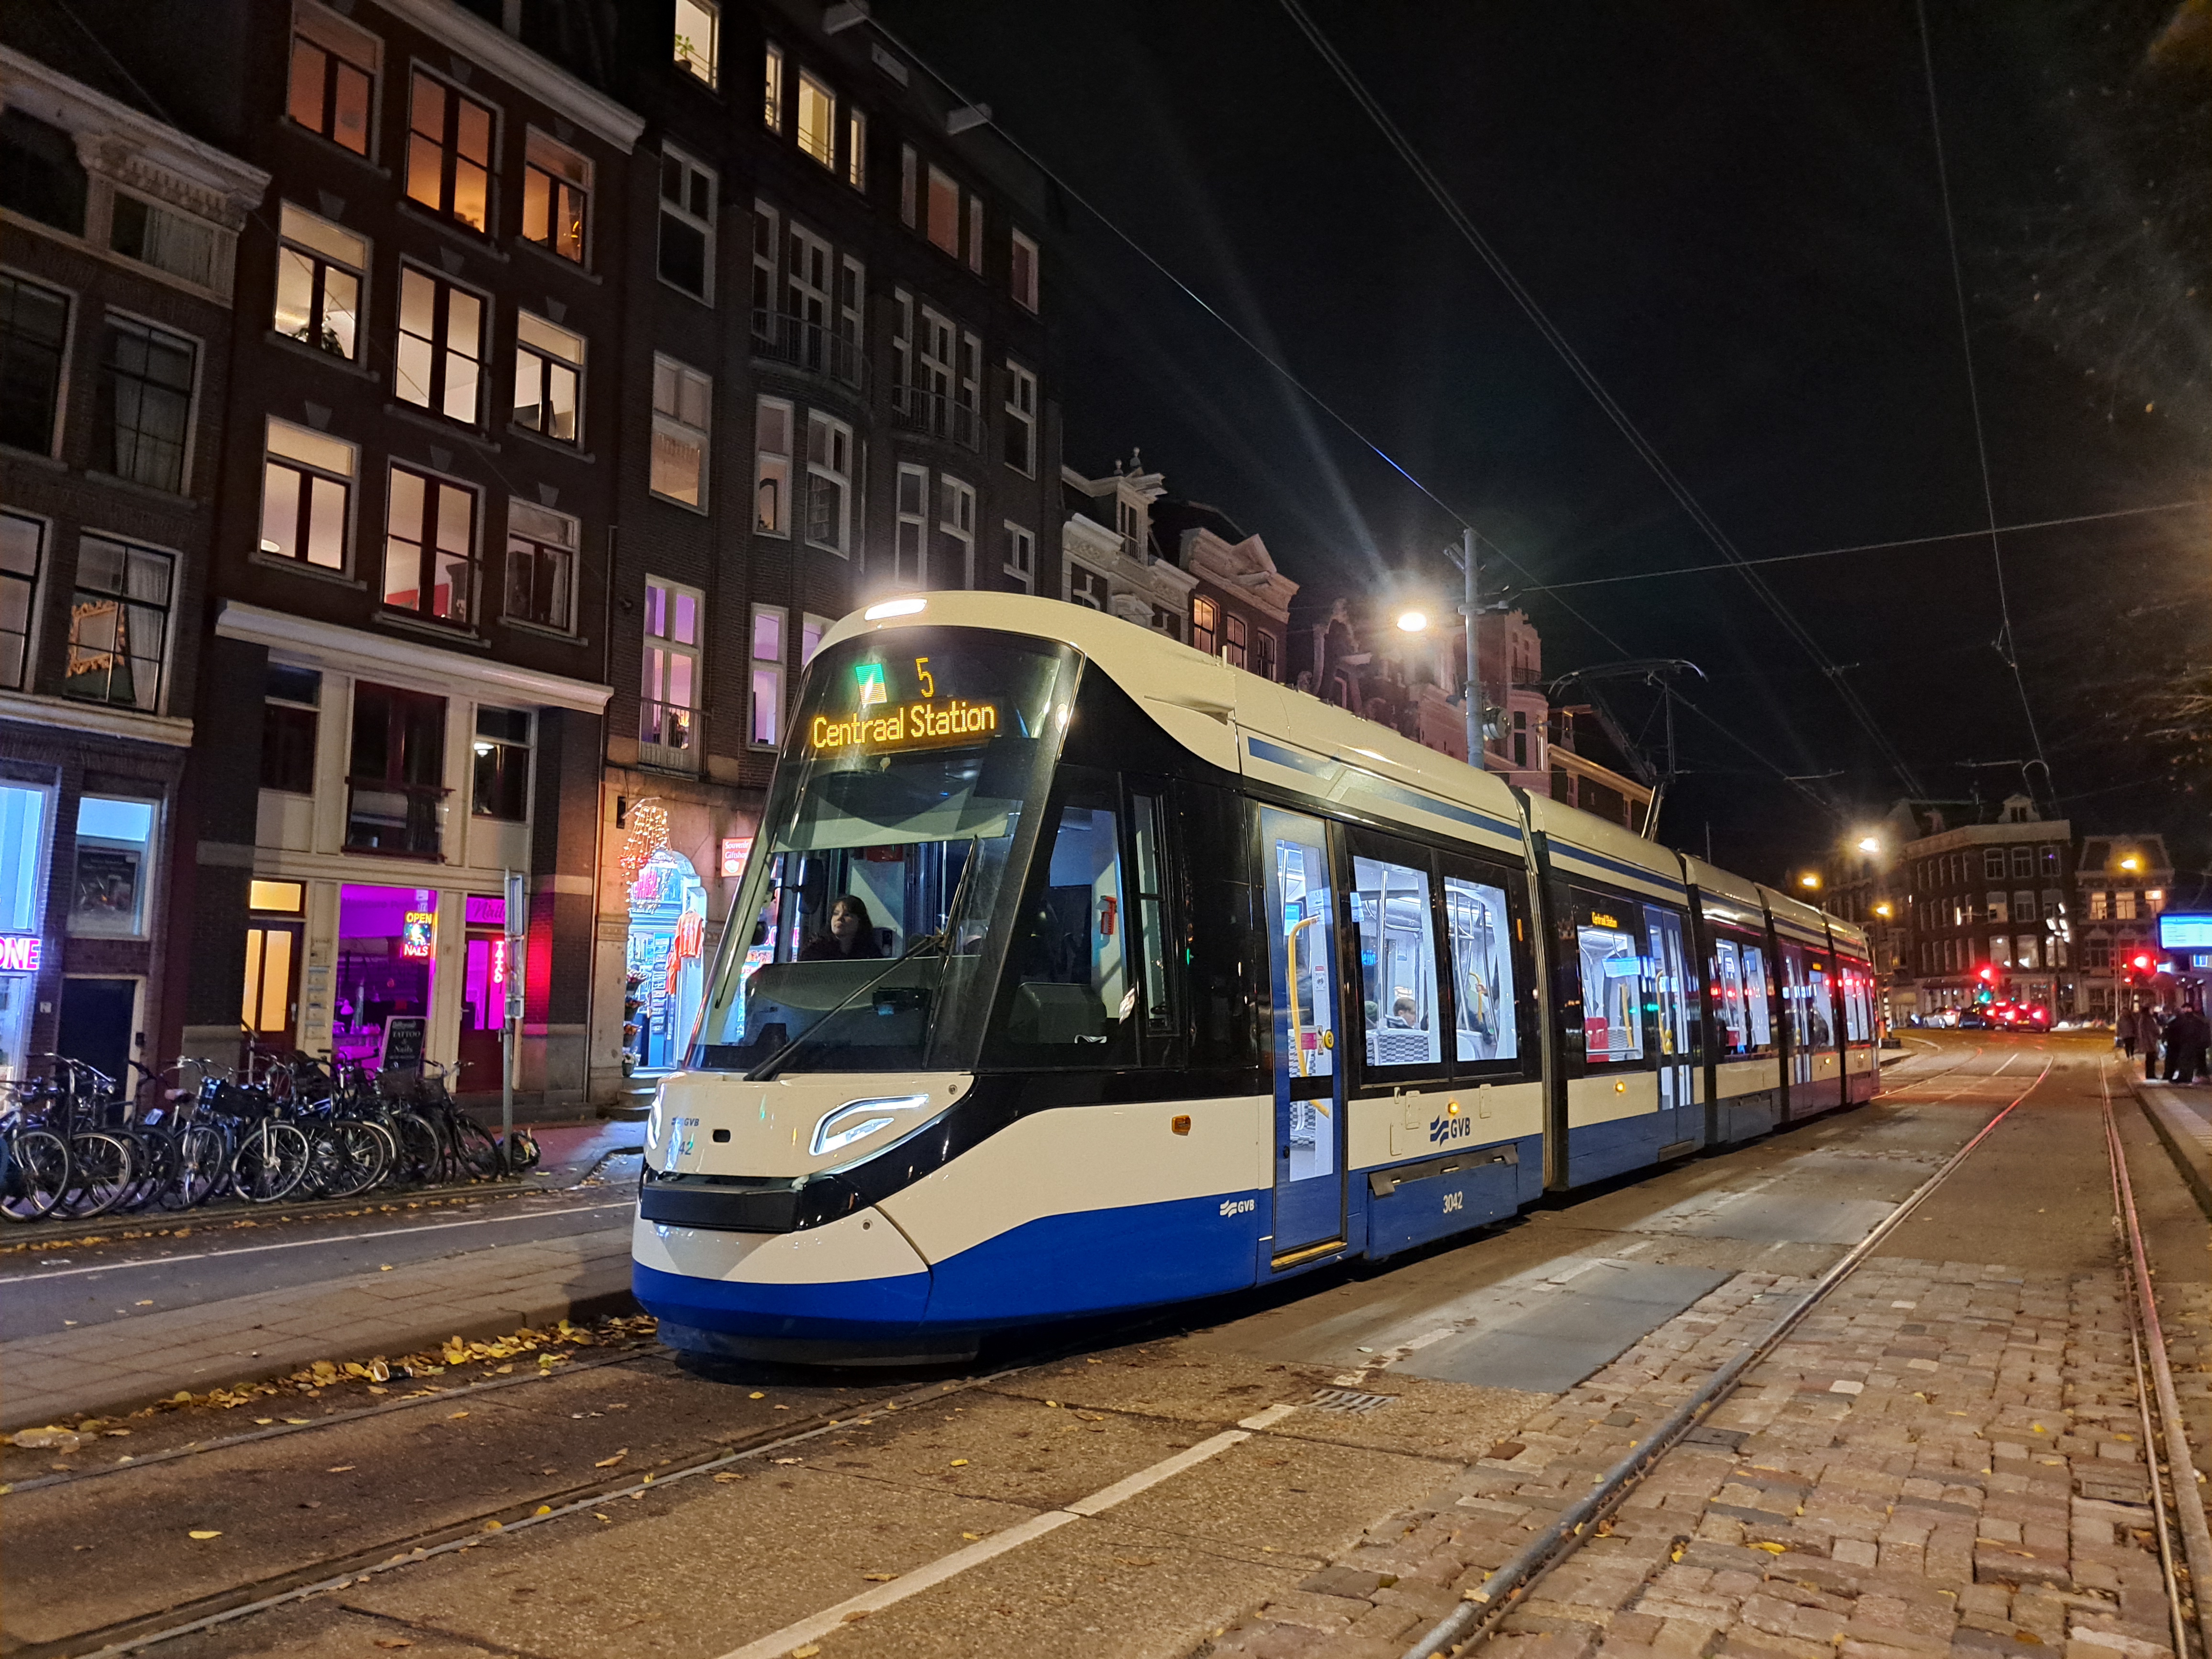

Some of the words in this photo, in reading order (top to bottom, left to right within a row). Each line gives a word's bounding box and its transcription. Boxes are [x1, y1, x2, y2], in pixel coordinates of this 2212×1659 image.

[916, 657, 934, 698] 5
[813, 707, 904, 749] Centraal
[910, 701, 995, 738] Station
[725, 841, 749, 849] Souvenir
[407, 912, 432, 924] OPEN
[684, 1117, 699, 1127] GVB
[1451, 1117, 1470, 1139] GVB
[666, 1140, 693, 1155] 42
[1238, 1199, 1254, 1213] GVB
[1443, 1191, 1463, 1214] 3042
